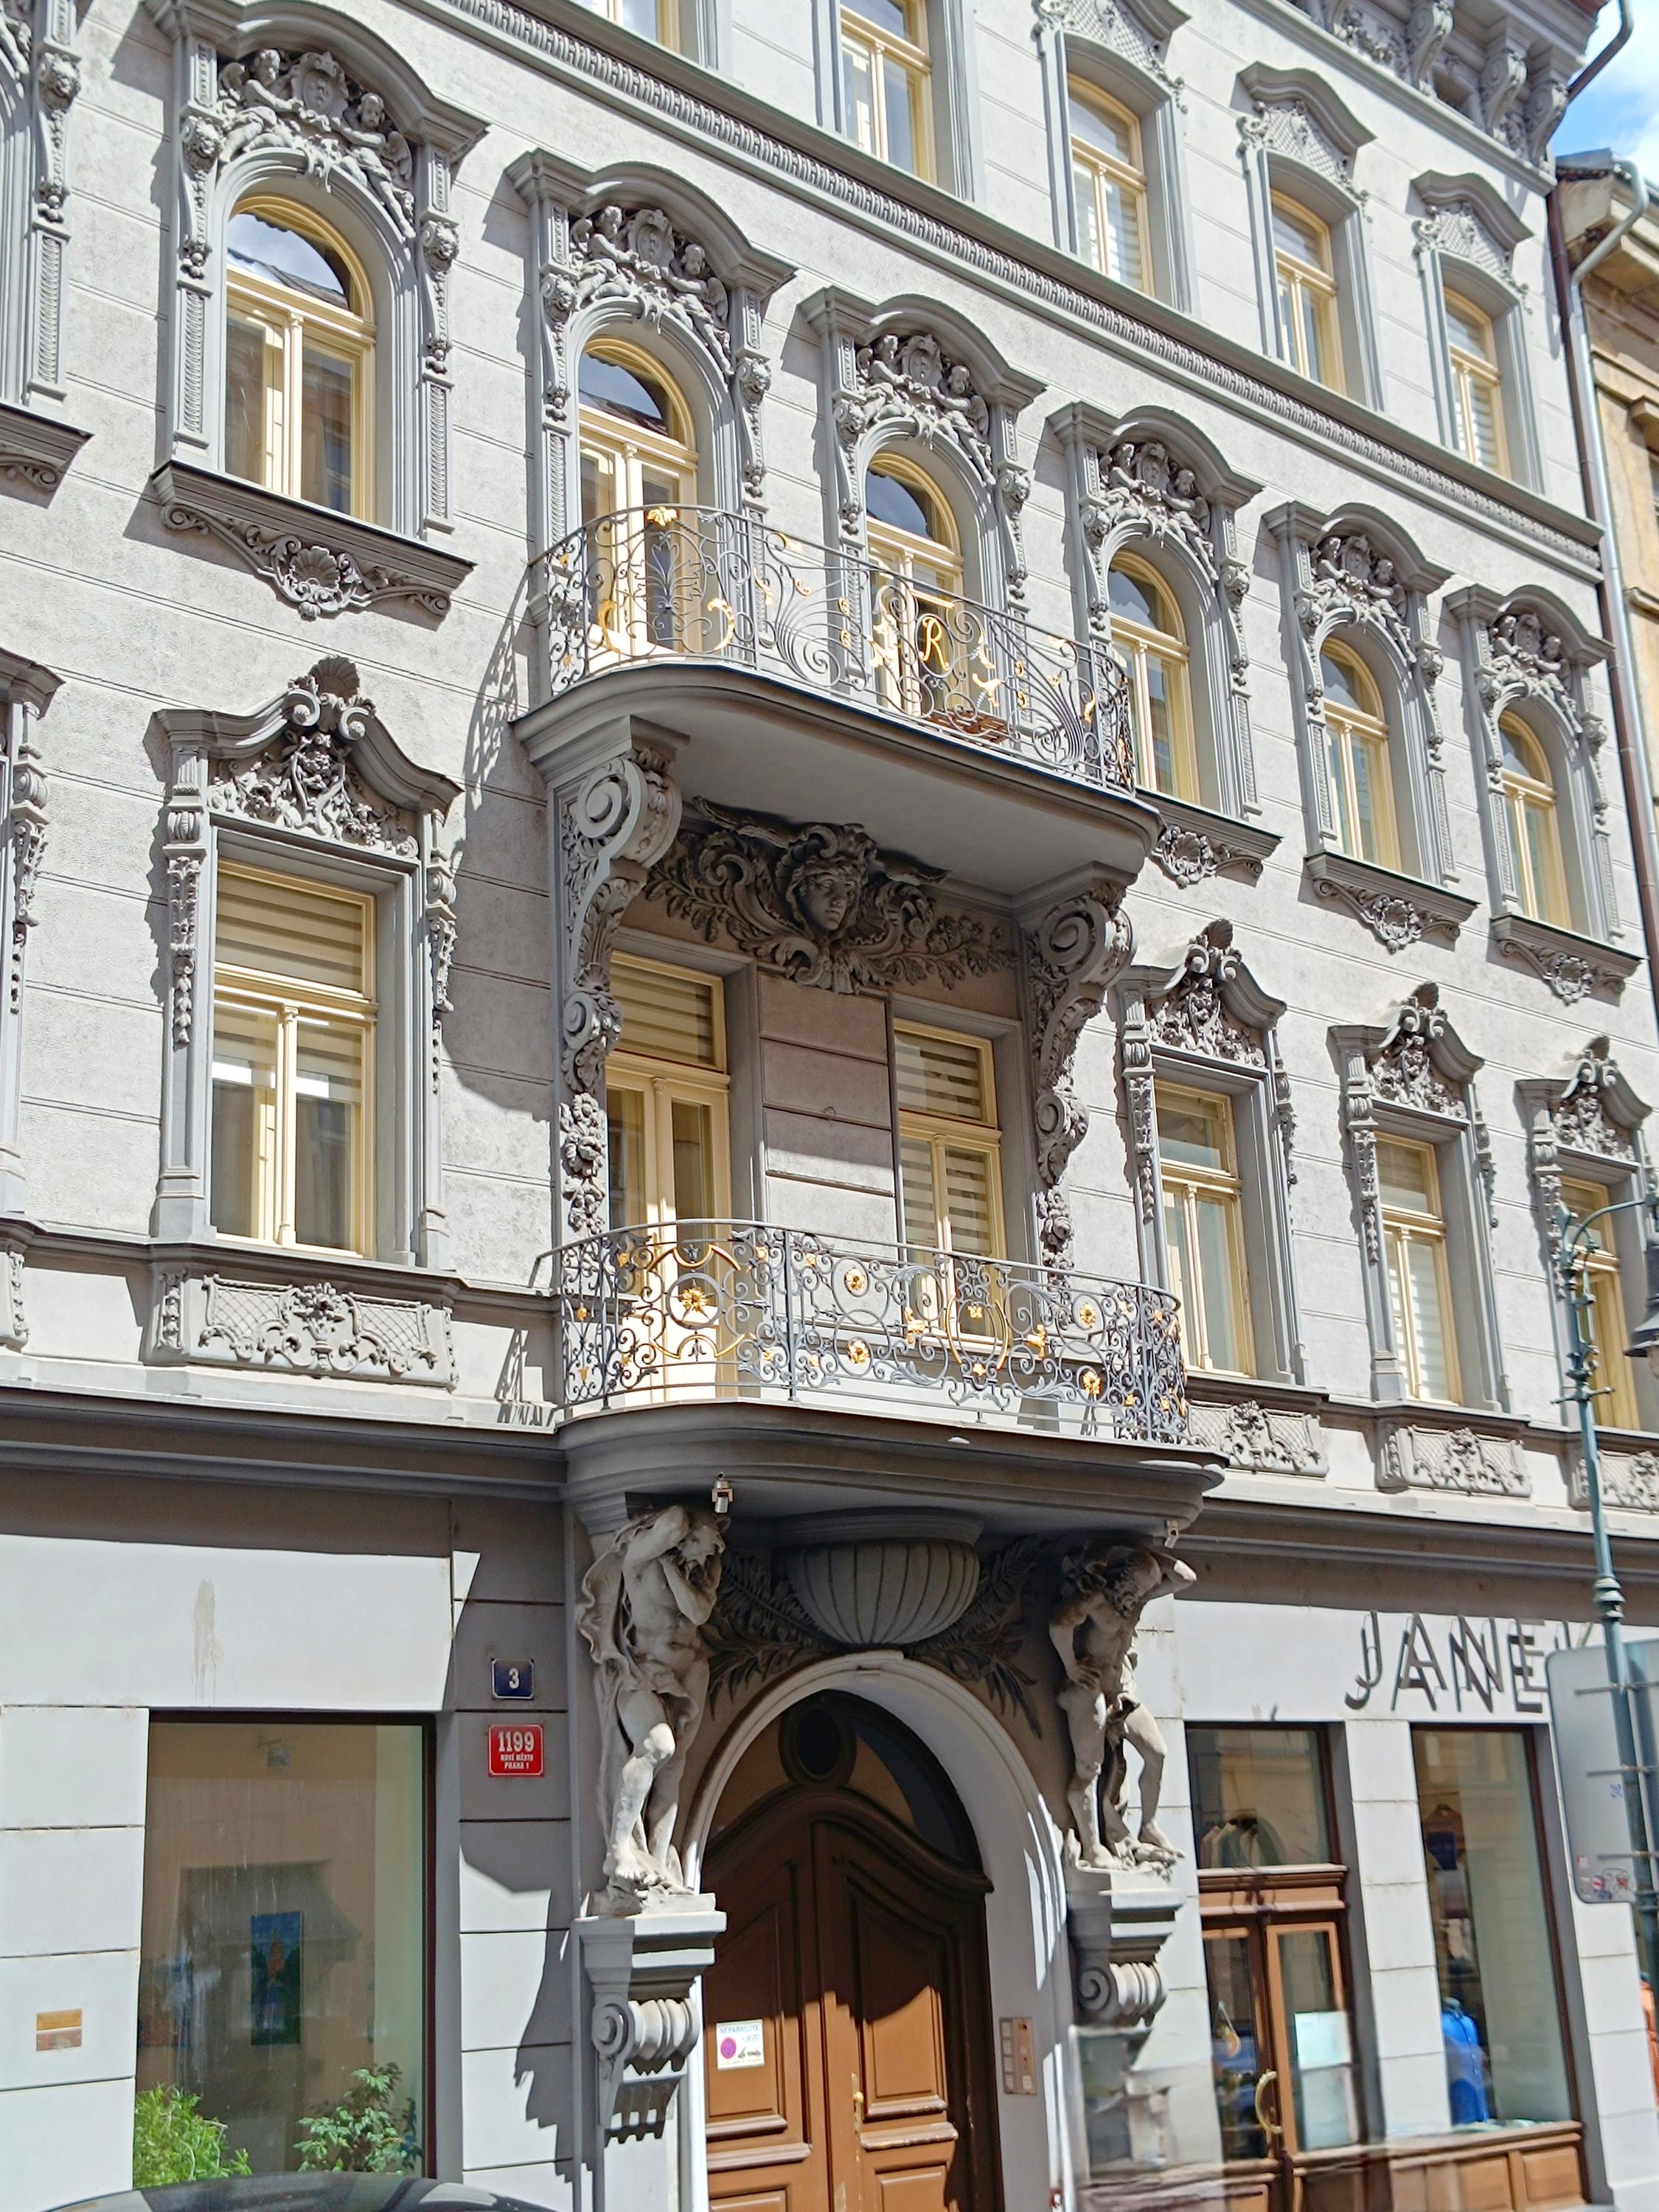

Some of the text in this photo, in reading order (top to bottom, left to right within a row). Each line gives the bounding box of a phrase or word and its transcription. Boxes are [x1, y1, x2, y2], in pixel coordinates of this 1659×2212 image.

[919, 616, 950, 671] R
[509, 1668, 520, 1688] 3
[498, 1731, 535, 1752] 1199
